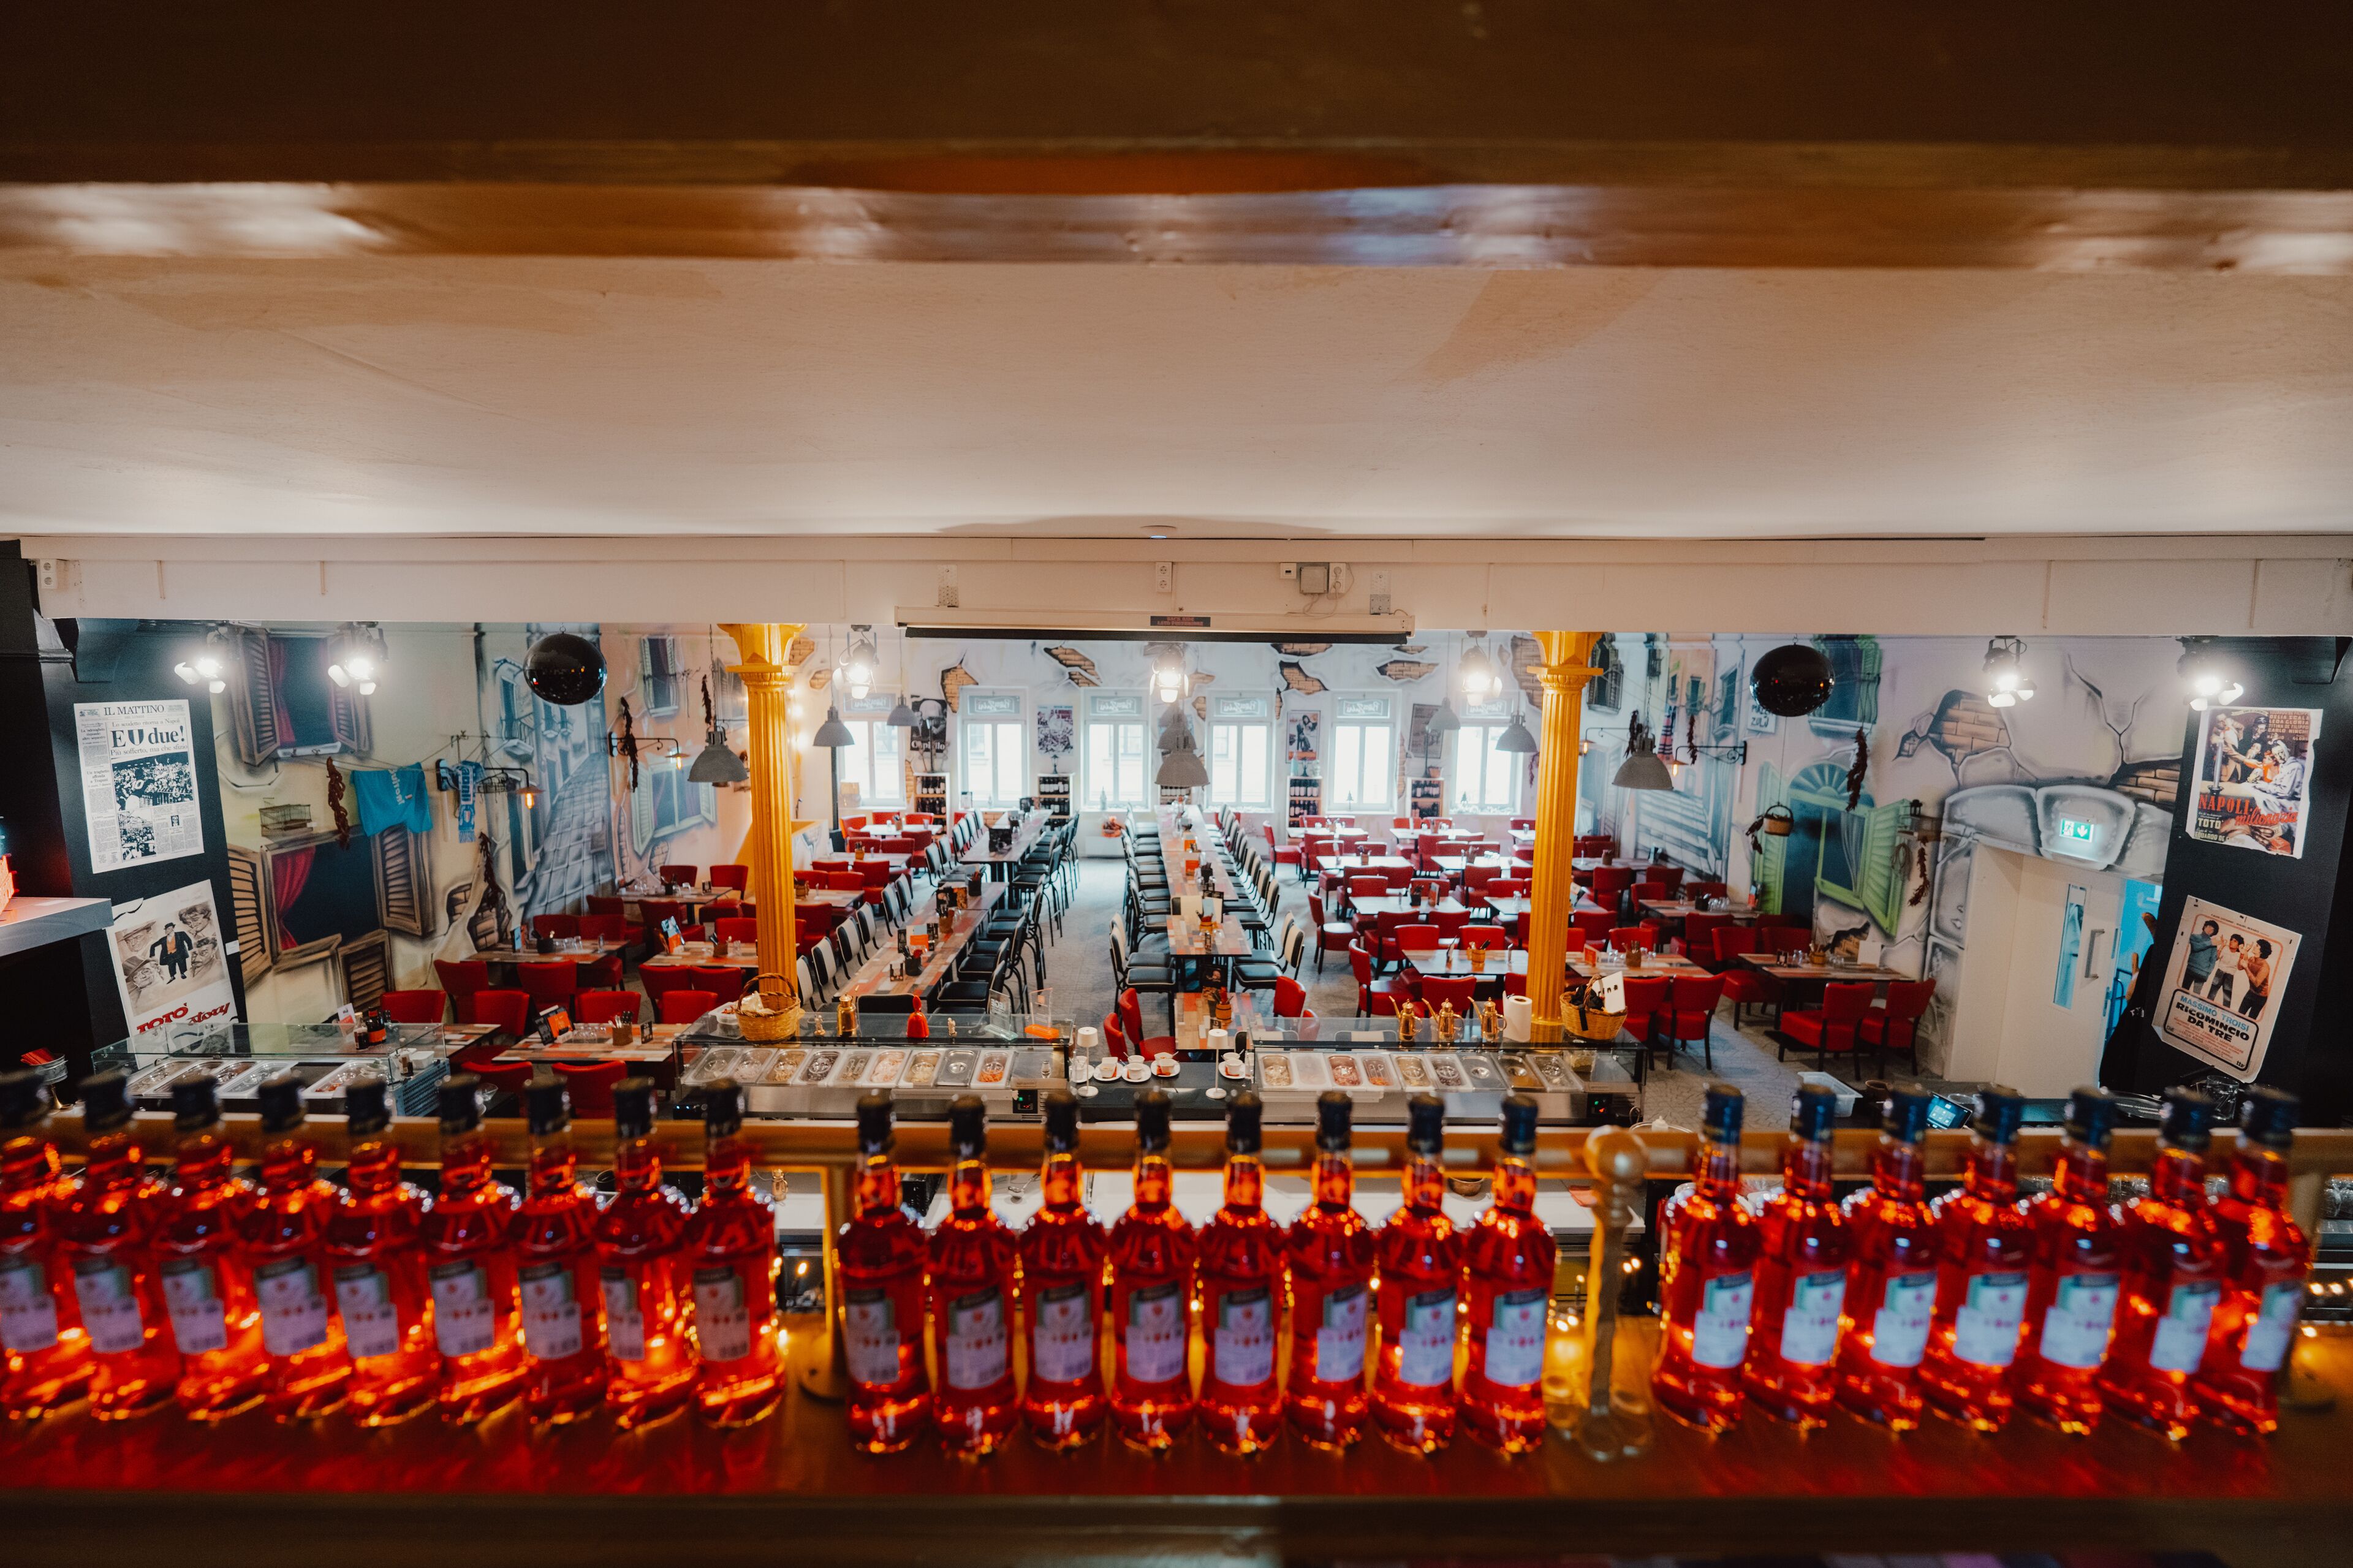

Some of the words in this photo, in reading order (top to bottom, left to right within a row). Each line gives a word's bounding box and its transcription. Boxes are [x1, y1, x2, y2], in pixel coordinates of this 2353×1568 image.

[104, 707, 115, 716] IL
[117, 705, 164, 716] MATTINO
[148, 725, 185, 745] due!
[123, 746, 148, 756] sofferto,
[2195, 831, 2217, 841] EDUARDO
[2176, 1002, 2249, 1041] RICOMINCIO
[2180, 996, 2217, 1017] MASSIMO
[2222, 1014, 2249, 1032] TROISI
[2188, 1015, 2204, 1029] DA
[2208, 1026, 2233, 1042] TRE
